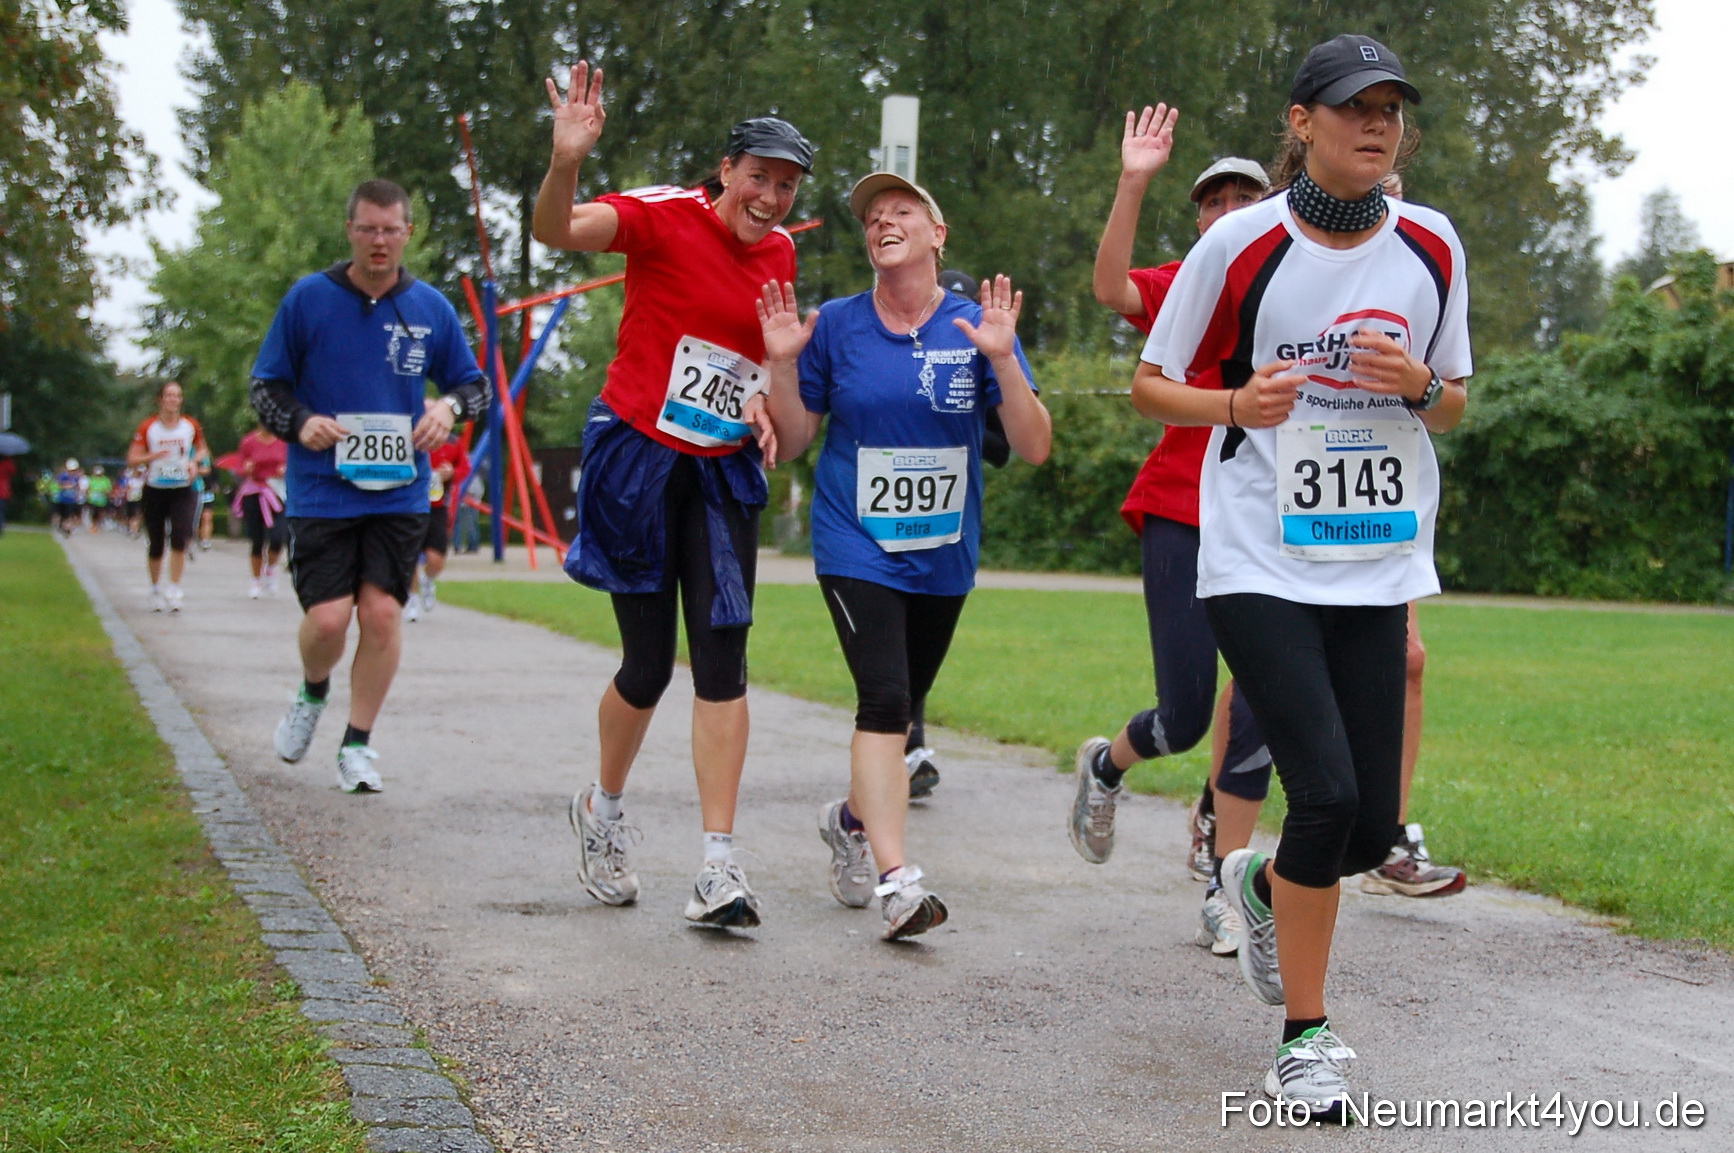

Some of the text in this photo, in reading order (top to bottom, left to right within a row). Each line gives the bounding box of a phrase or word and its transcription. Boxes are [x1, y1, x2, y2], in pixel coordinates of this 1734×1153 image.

[679, 366, 744, 420] 2455
[1306, 394, 1364, 410] sportliche
[1325, 429, 1373, 443] BOCK
[346, 434, 407, 462] 2868
[893, 456, 937, 466] BOCK
[1293, 456, 1404, 510] 3143
[870, 474, 958, 513] 2997
[895, 522, 931, 536] Petra
[1311, 520, 1392, 540] Christine
